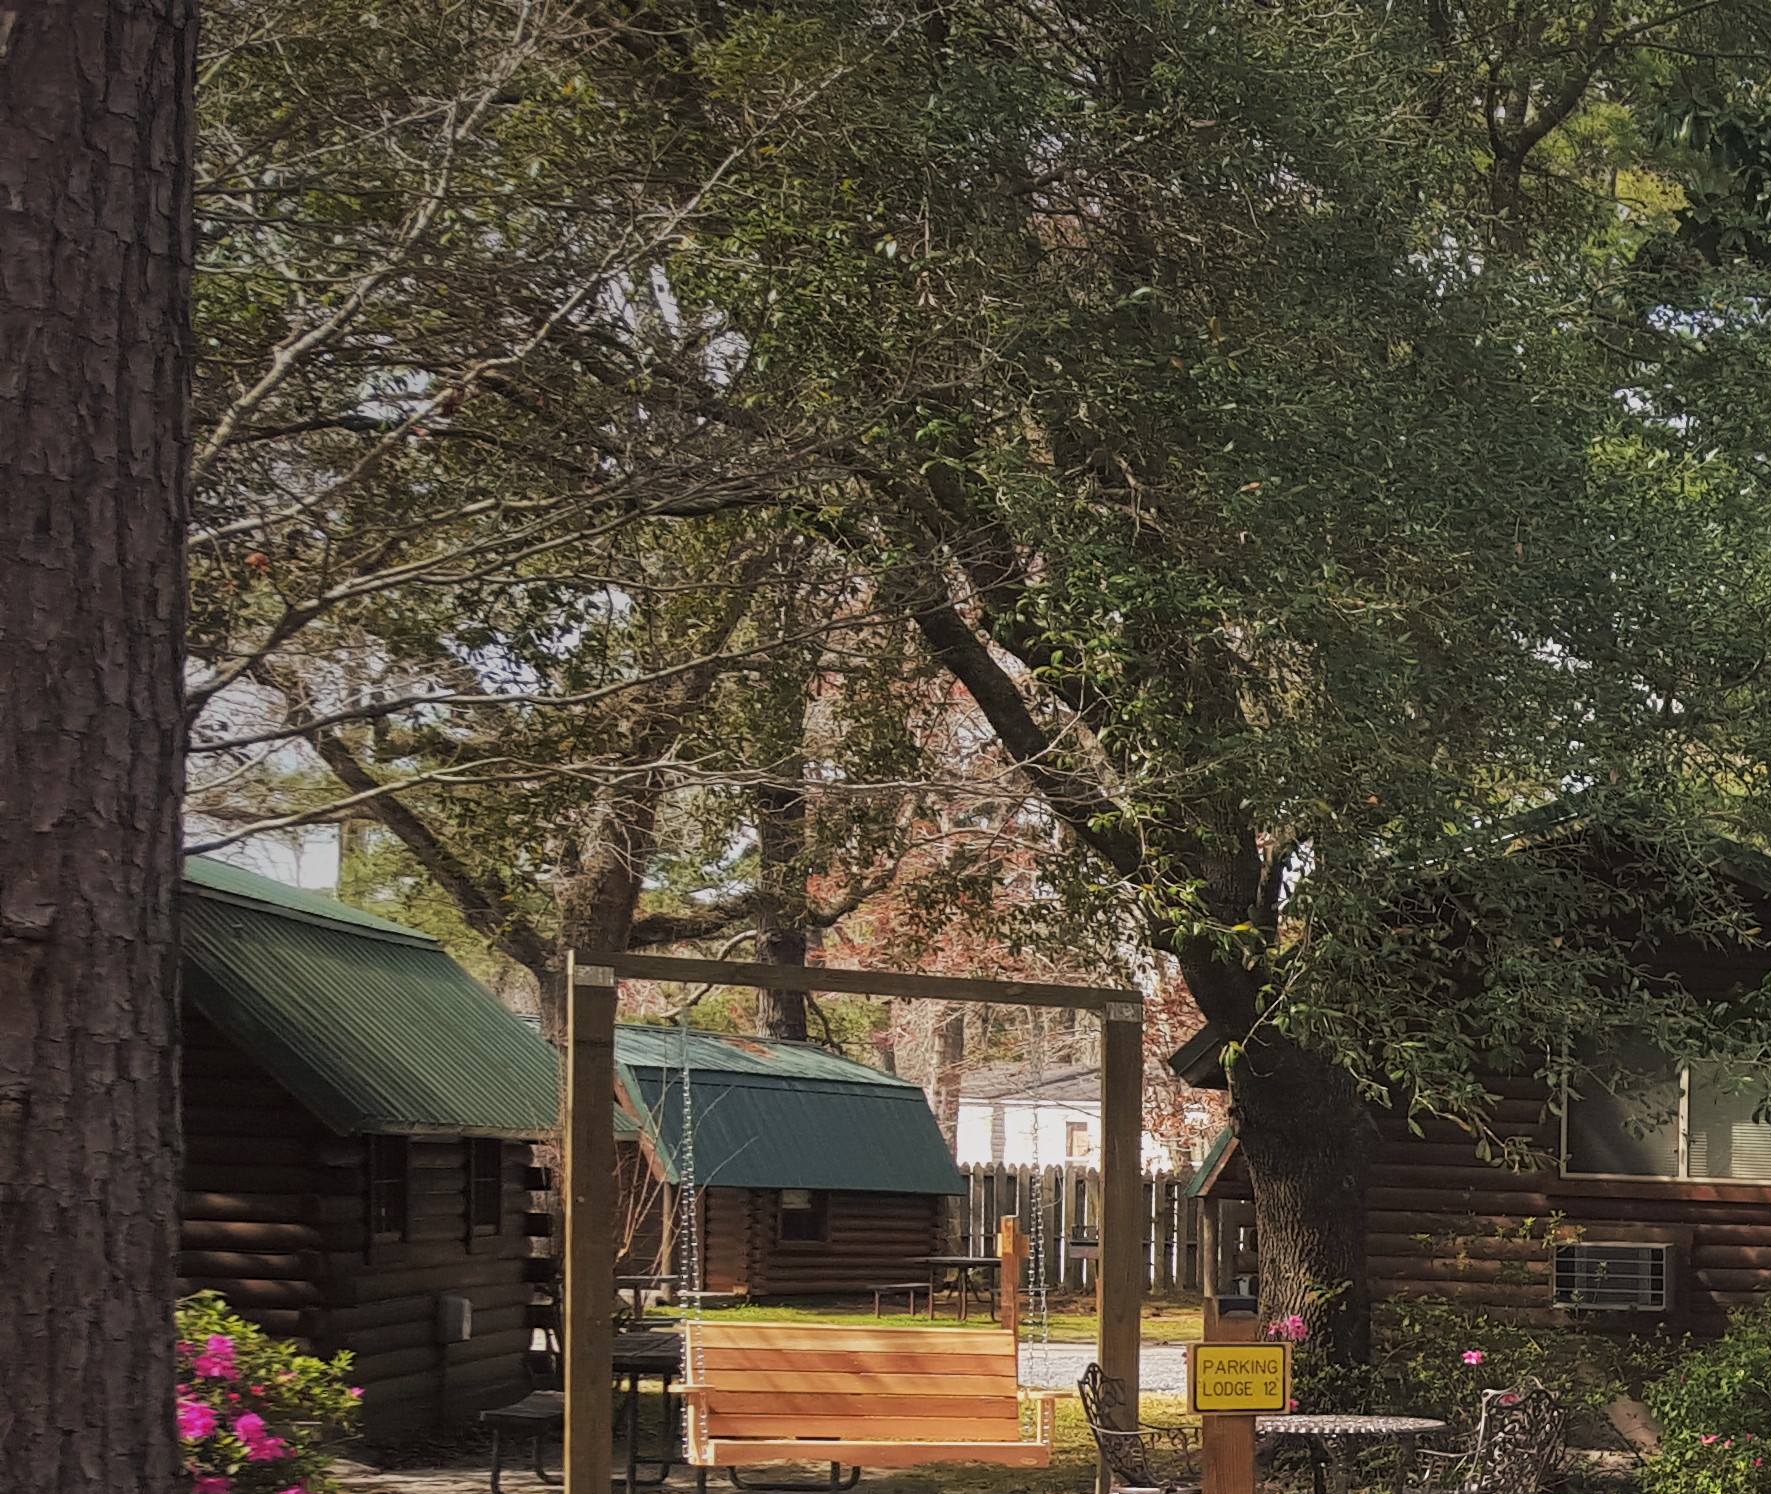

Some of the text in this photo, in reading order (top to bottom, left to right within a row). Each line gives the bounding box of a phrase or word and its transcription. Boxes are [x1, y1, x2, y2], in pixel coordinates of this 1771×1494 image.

[1202, 1359, 1278, 1375] PARKING
[1202, 1381, 1278, 1397] LODGE 12
